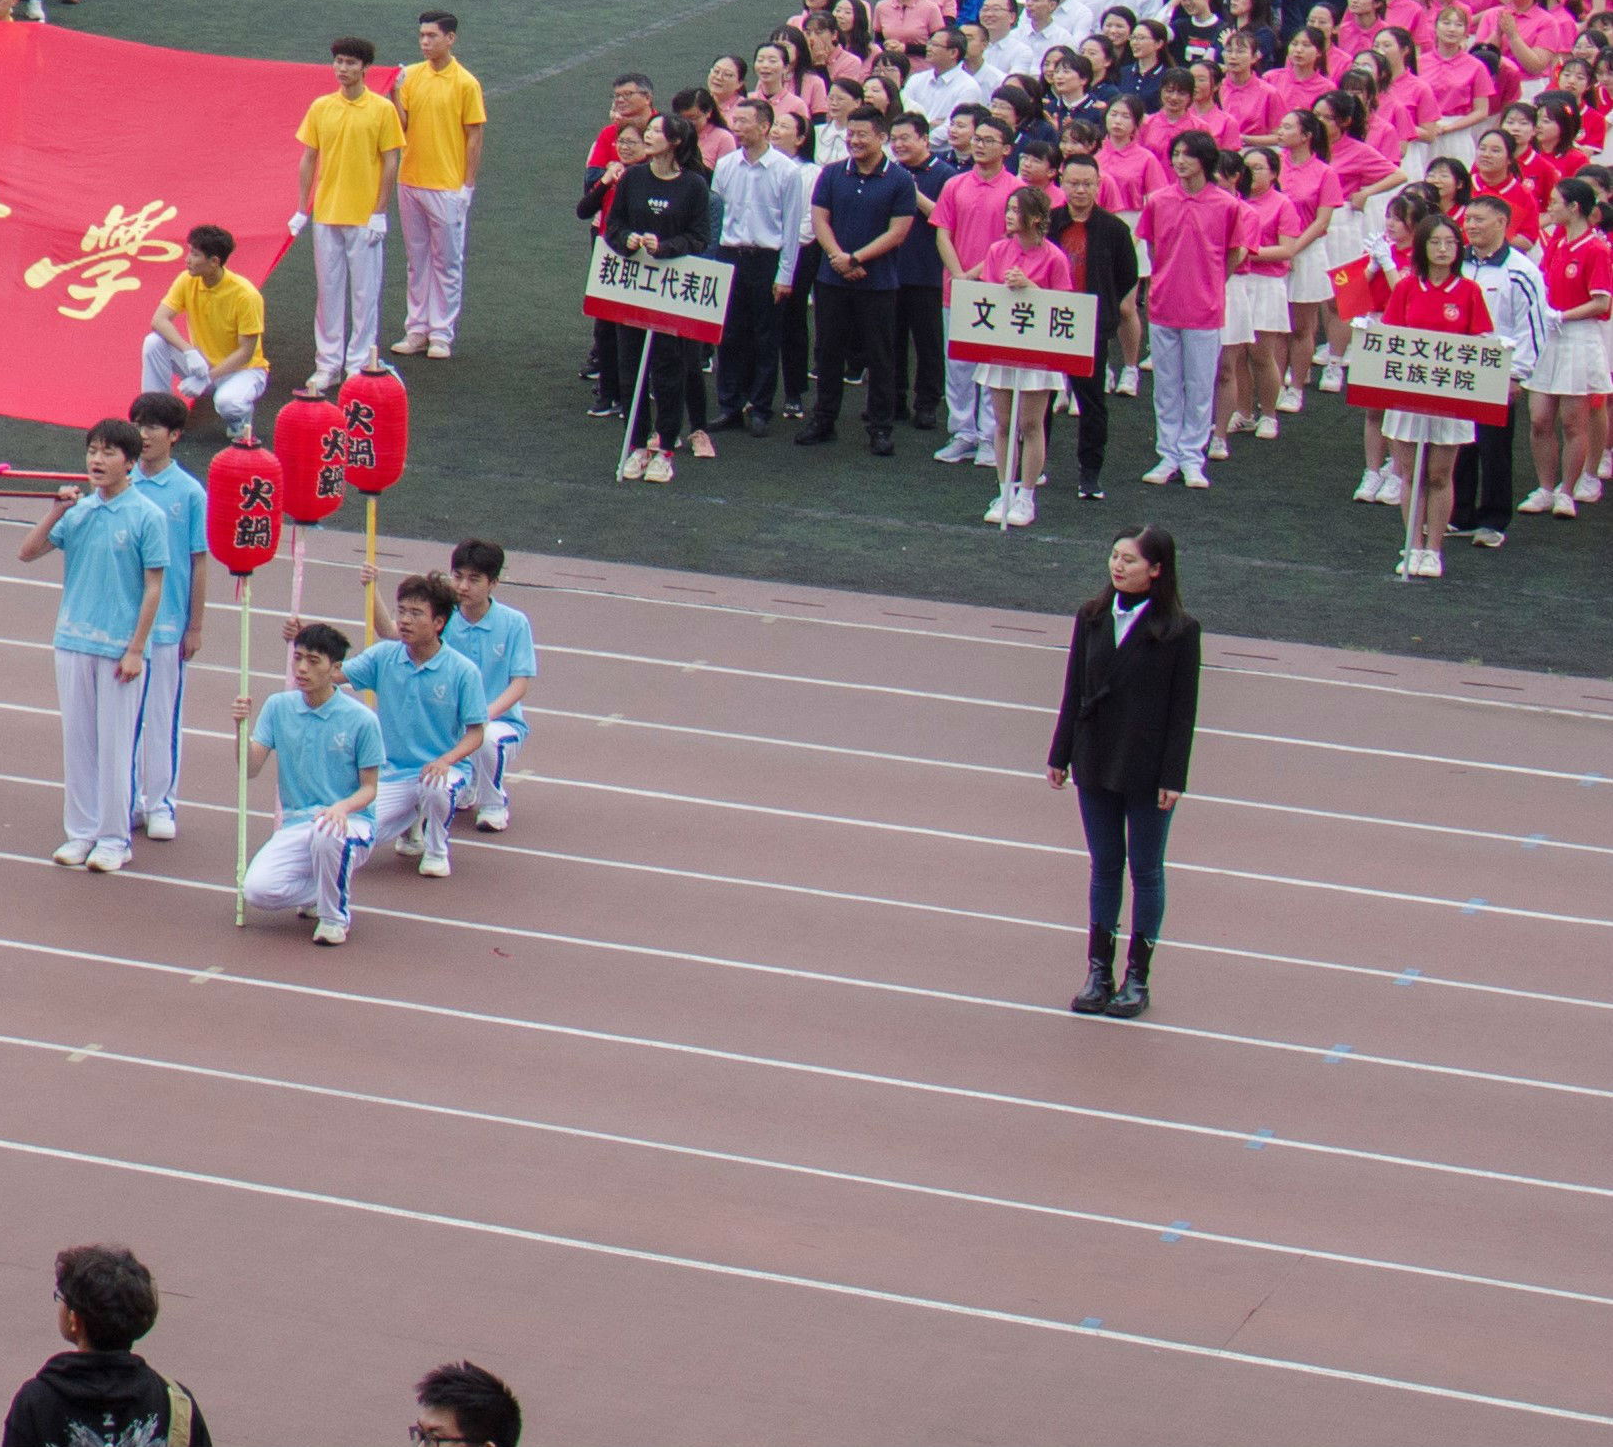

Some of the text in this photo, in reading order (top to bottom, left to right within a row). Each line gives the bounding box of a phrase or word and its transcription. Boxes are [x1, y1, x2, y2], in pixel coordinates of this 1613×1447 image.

[598, 253, 719, 310] 教职工代表队
[971, 298, 1076, 340] 文学院
[1363, 331, 1503, 371] 历史文化学院
[1383, 361, 1477, 393] 民族学院
